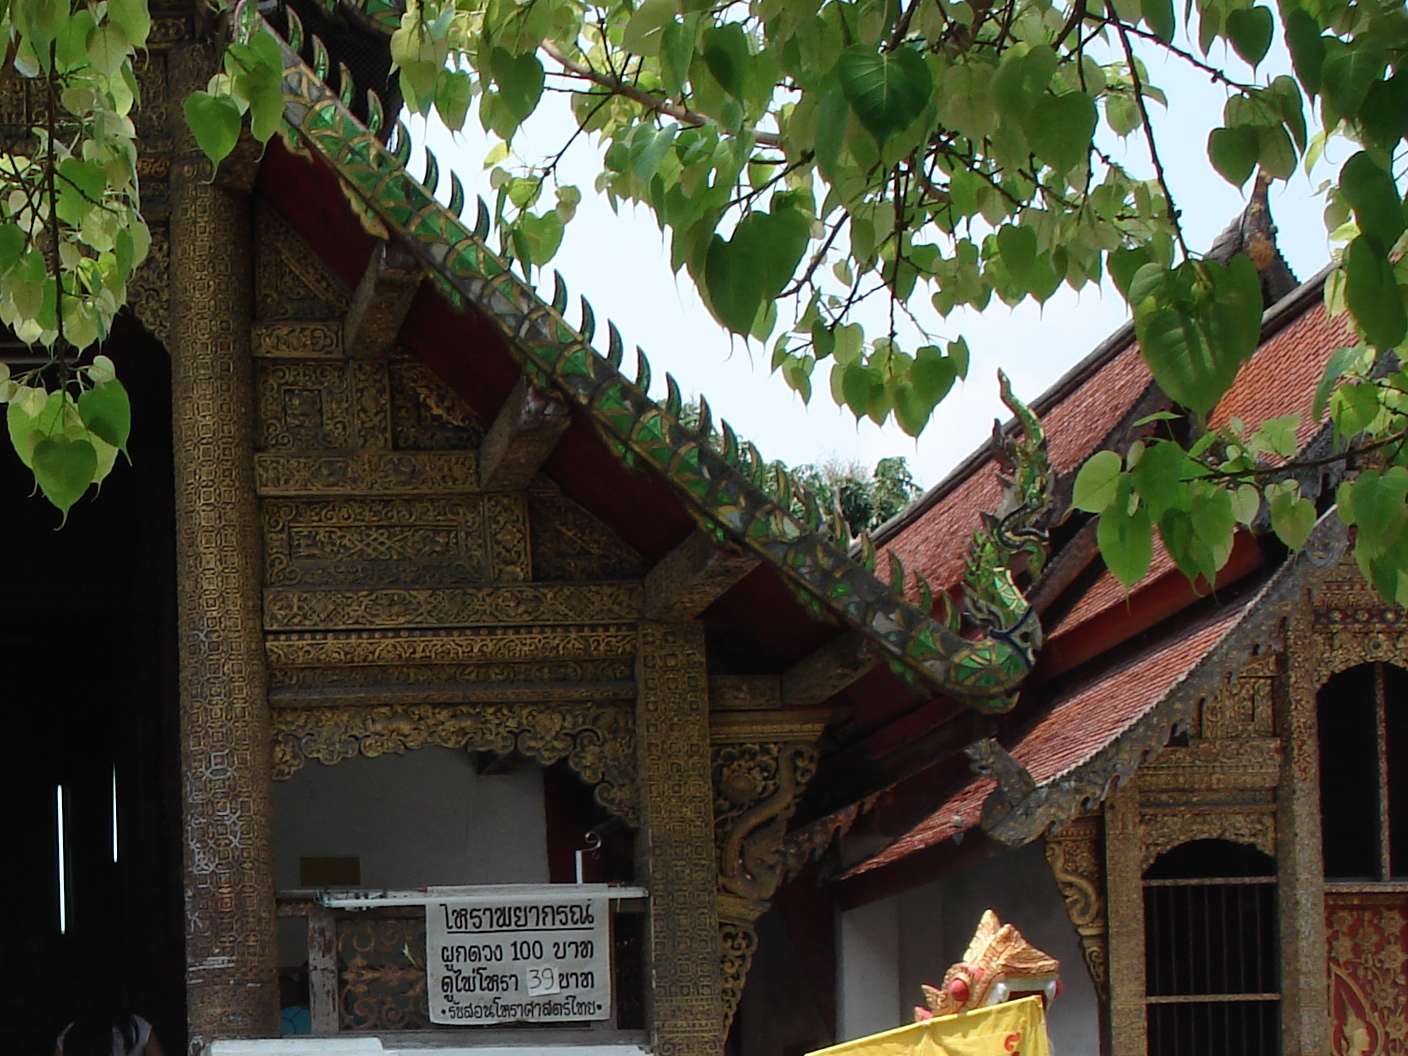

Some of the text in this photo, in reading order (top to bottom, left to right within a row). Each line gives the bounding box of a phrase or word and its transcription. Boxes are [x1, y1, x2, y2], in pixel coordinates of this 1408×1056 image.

[441, 940, 595, 972] ผูกดวง 100 บาท
[441, 967, 595, 1003] ดูไพ่โหรา 39 บาท
